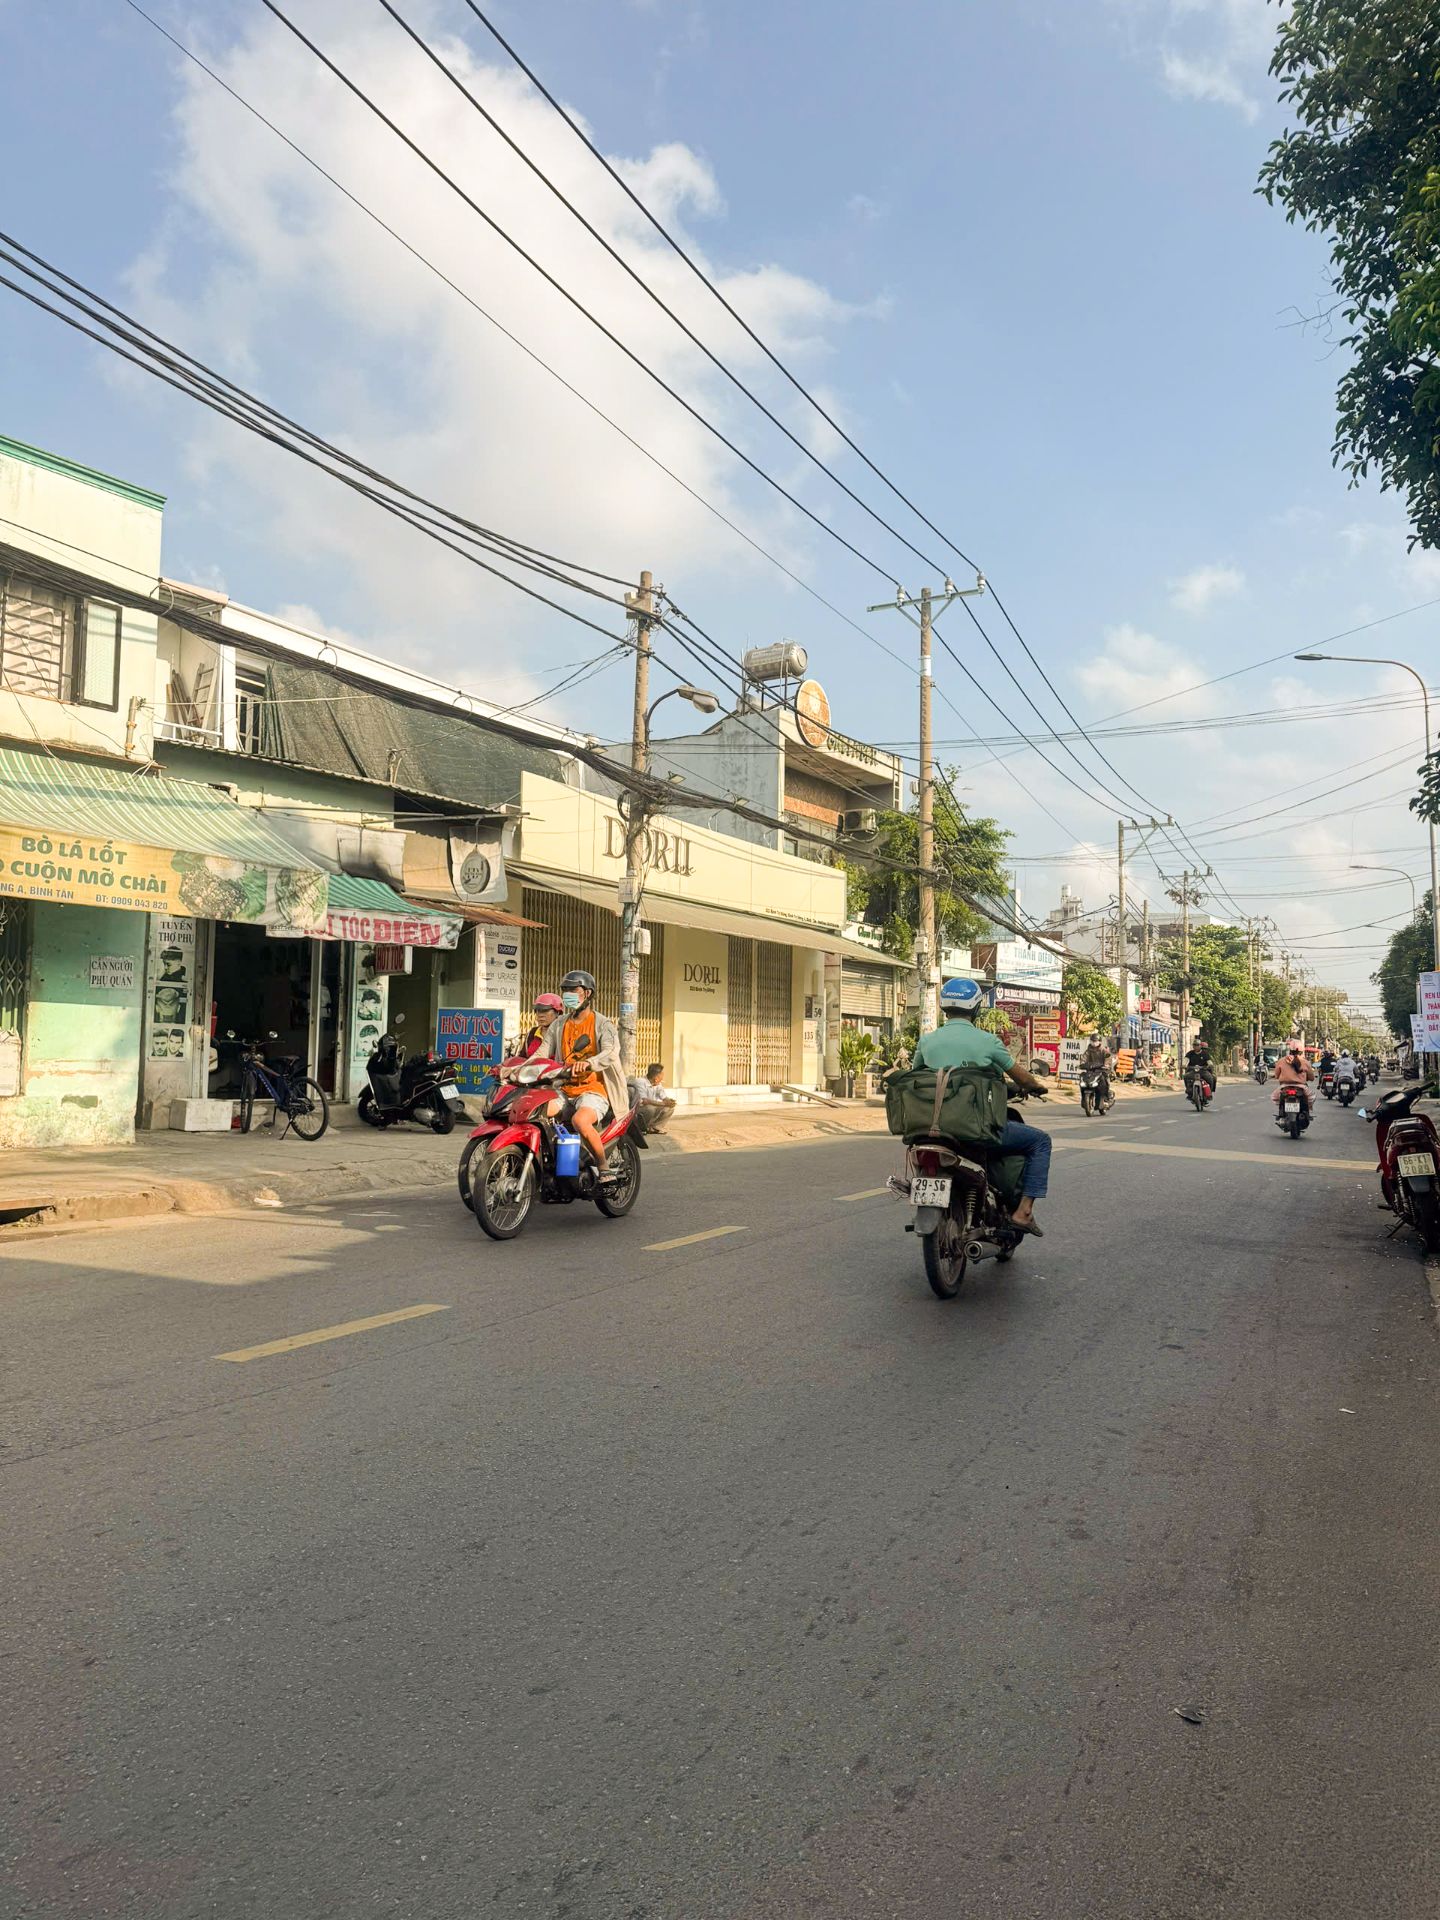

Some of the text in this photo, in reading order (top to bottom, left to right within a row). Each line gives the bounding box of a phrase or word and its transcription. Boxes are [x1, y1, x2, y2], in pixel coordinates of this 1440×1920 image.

[21, 834, 128, 865] BÒ LÁ LỐT
[10, 860, 73, 884] CUỘN
[77, 867, 115, 887] MỠ
[119, 874, 167, 894] CHÀI
[111, 896, 132, 906] 0909
[134, 898, 150, 908] 043
[152, 900, 168, 910] 820
[340, 912, 371, 942] TÓC
[373, 915, 441, 946] ĐIỀN
[471, 1012, 501, 1036] TÓC
[446, 1035, 494, 1060] ĐIỀN
